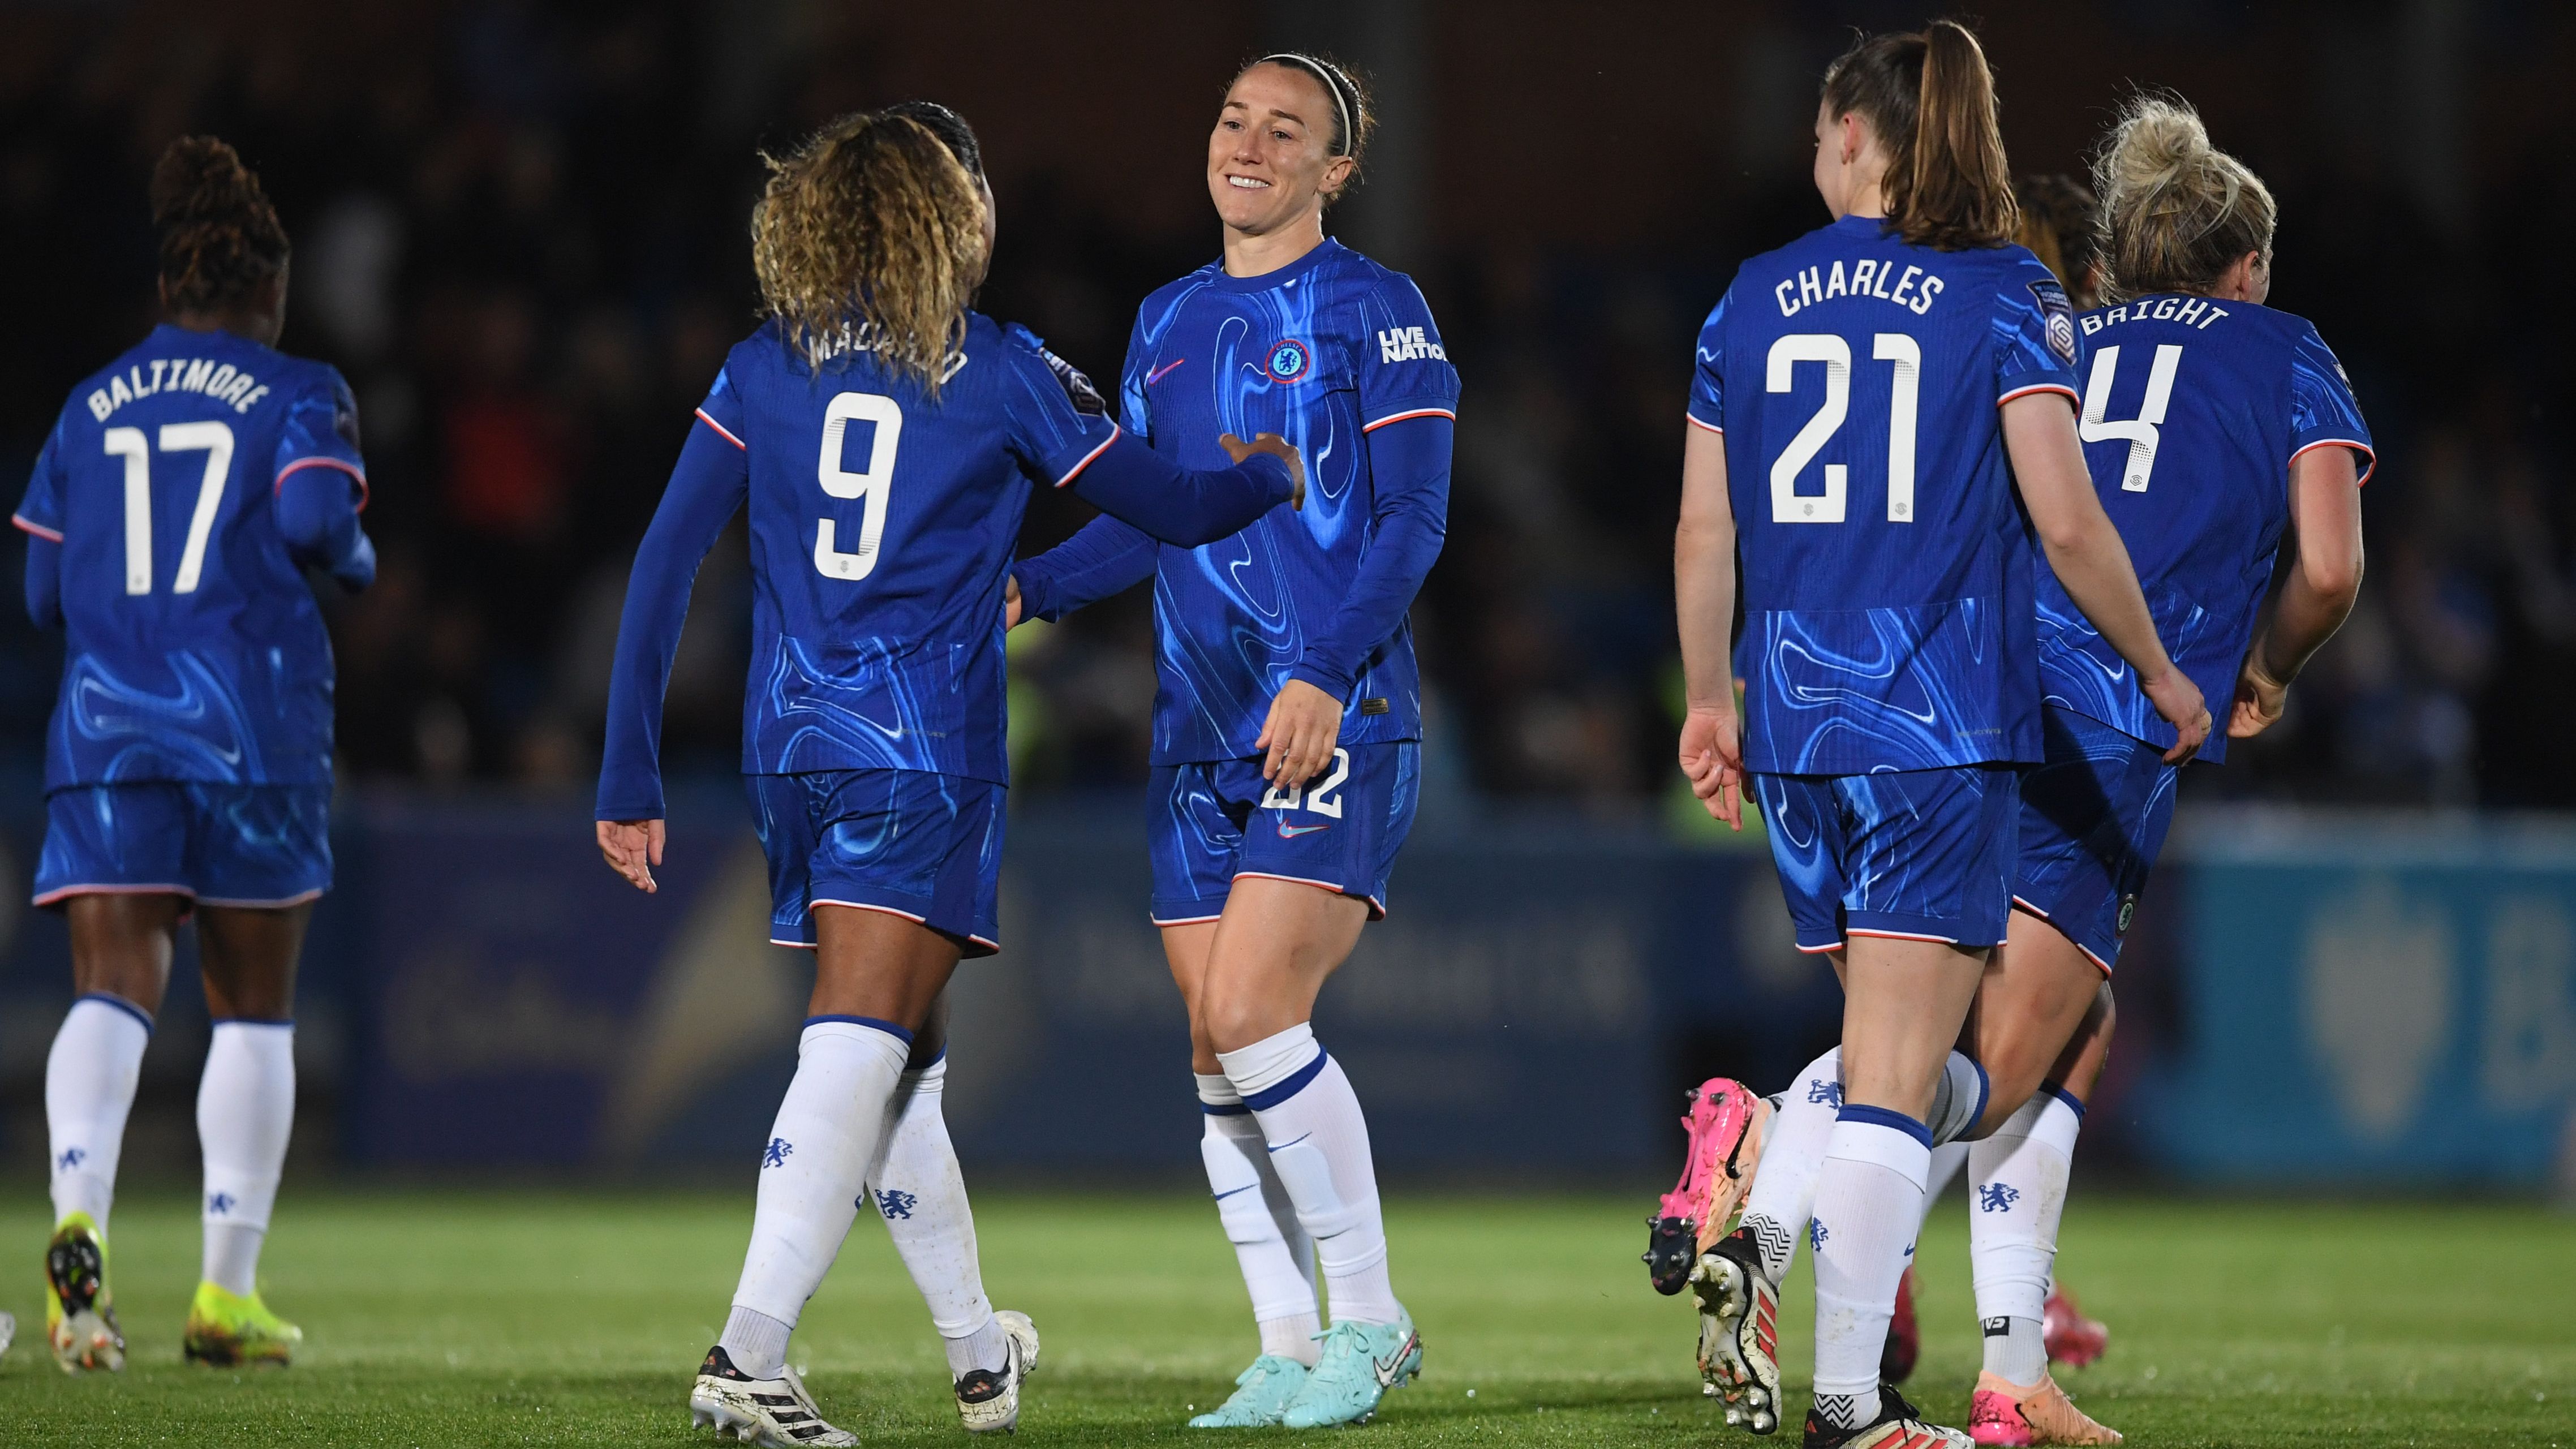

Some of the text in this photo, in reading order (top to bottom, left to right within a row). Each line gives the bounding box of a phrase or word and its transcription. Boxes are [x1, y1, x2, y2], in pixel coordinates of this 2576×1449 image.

[1775, 259, 1945, 317] CHARLES
[2080, 298, 2229, 336] BRIGHT
[809, 321, 967, 384] MACO
[1378, 326, 1425, 347] LIVE
[88, 358, 269, 422] BALTIMORE
[2079, 344, 2183, 492] 4
[1766, 333, 1921, 523] 21
[104, 420, 234, 595] 17
[814, 392, 902, 581] 9
